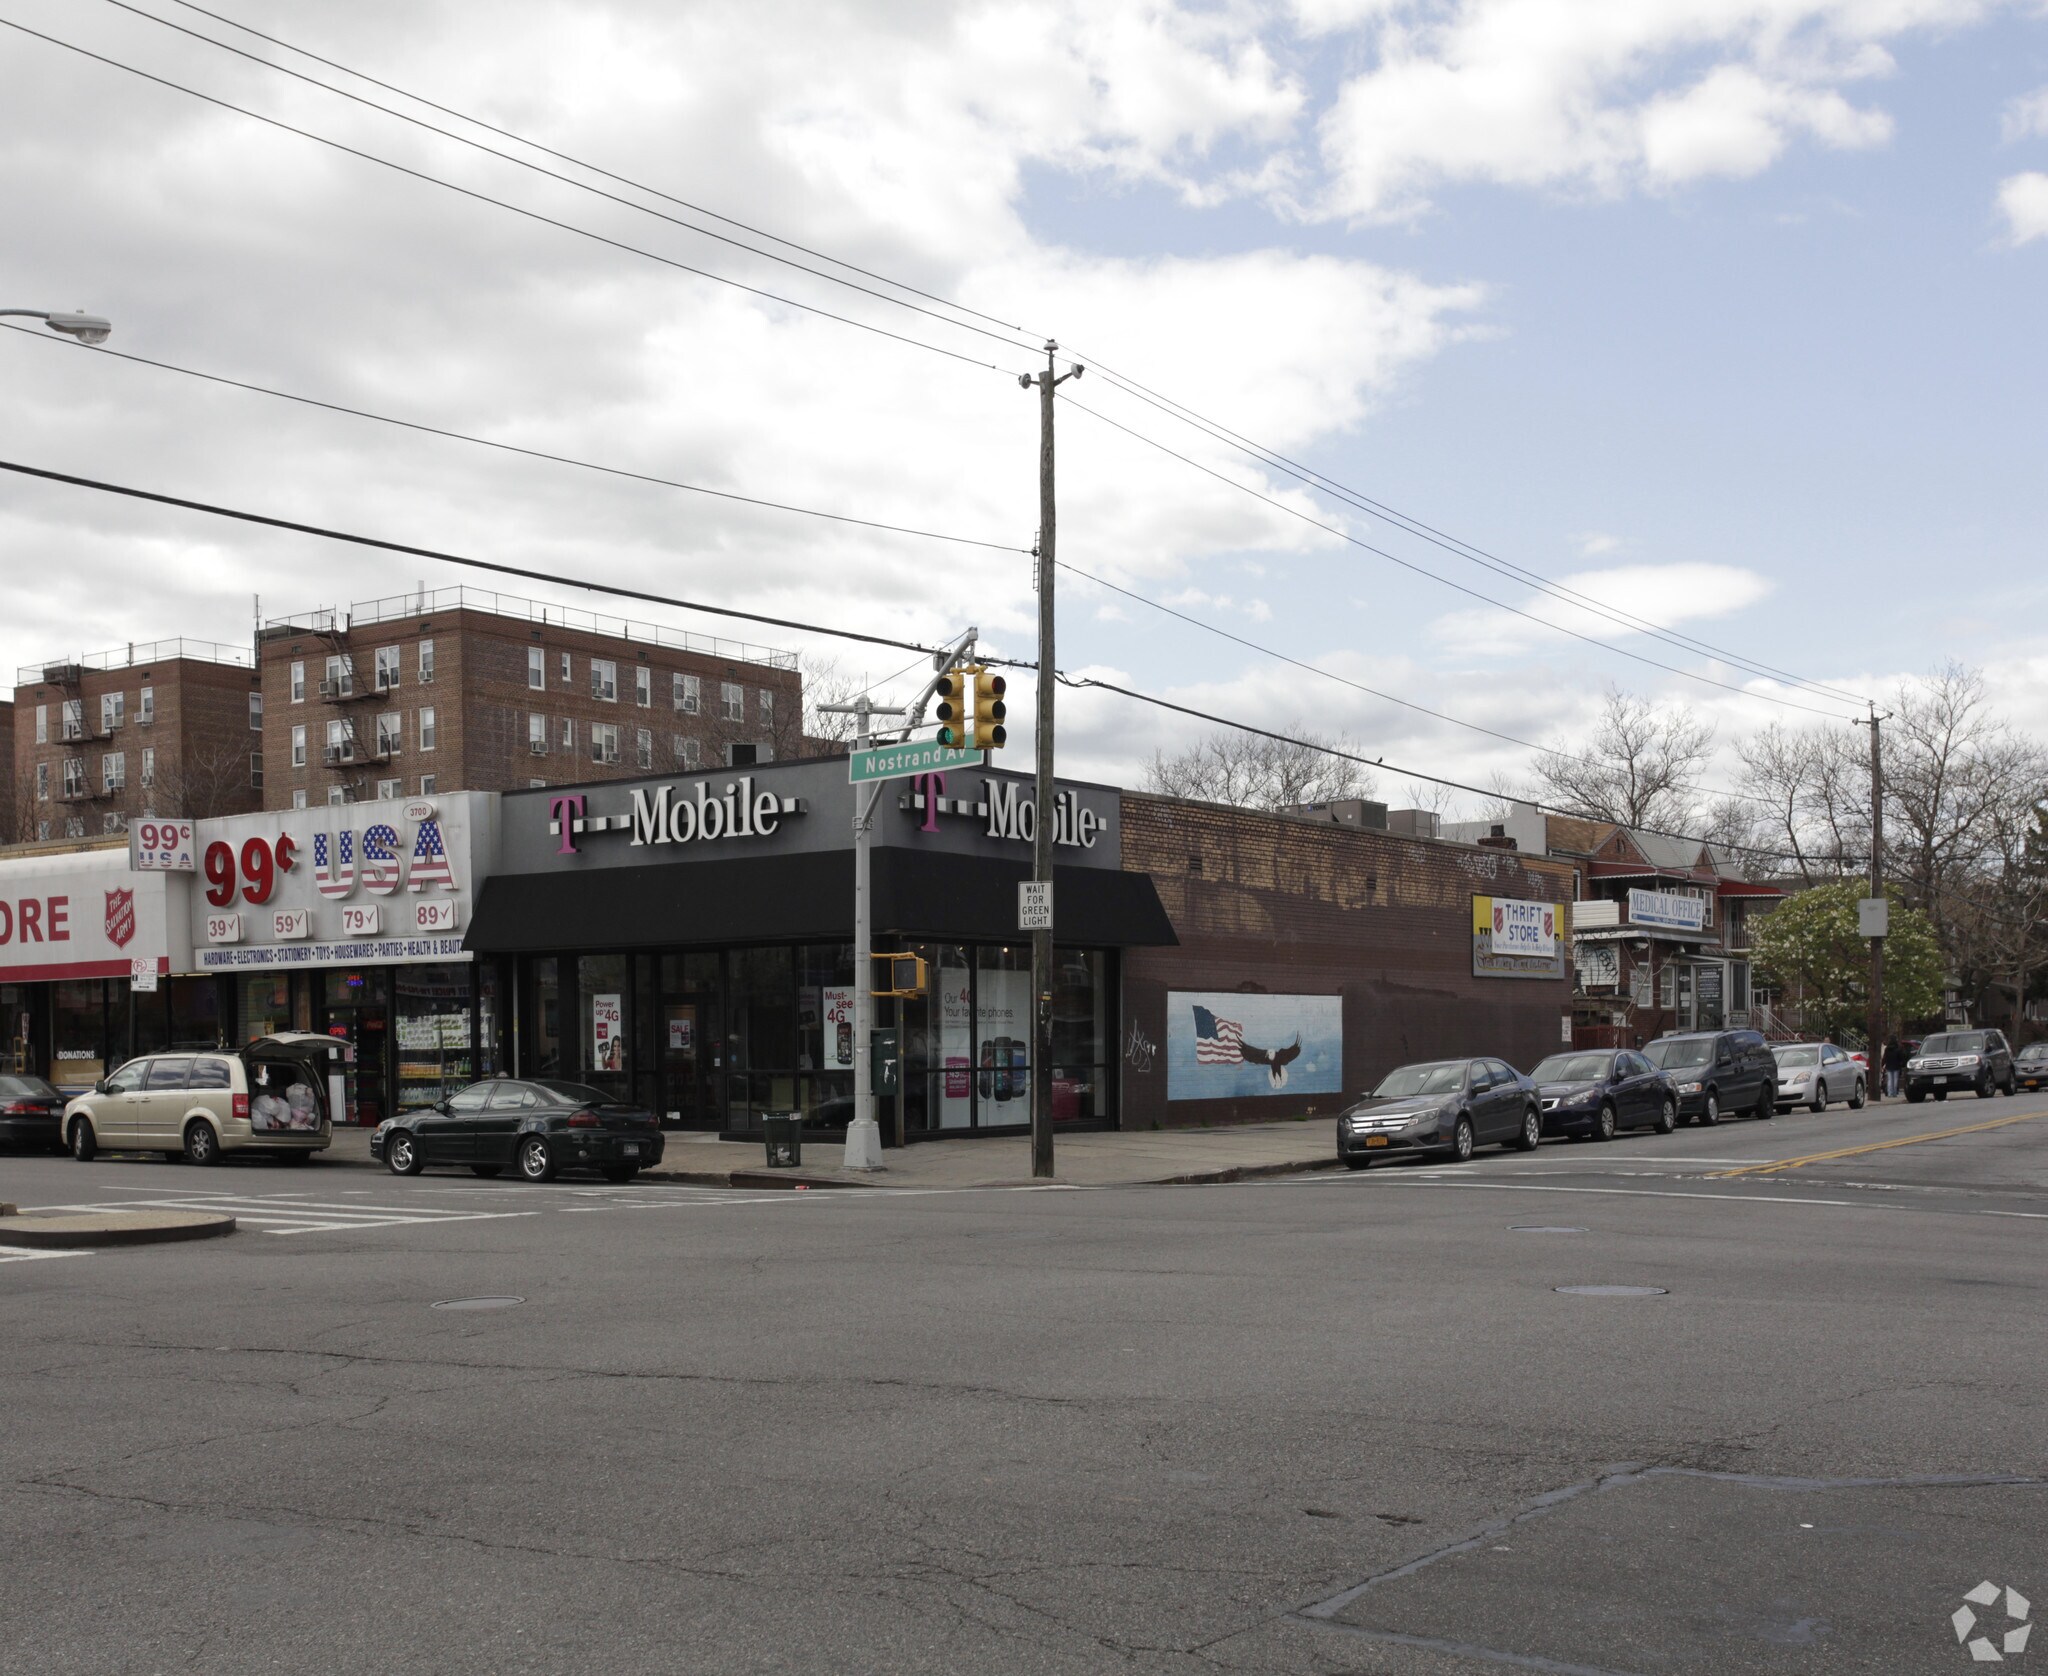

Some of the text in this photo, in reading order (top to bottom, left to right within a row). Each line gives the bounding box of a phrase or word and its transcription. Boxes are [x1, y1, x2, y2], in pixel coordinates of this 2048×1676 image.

[866, 745, 941, 774] Nostrand
[410, 807, 427, 817] 3700
[314, 821, 459, 899] USA
[204, 832, 302, 907] 99¢
[1026, 885, 1045, 894] WAIT
[109, 892, 122, 913] THE
[1027, 895, 1044, 905] FOR
[1631, 892, 1702, 920] MEDICAL OFFICE
[105, 897, 132, 935] SALVATION
[1022, 905, 1049, 915] GREEN
[1505, 904, 1542, 923] THRIFT
[1024, 916, 1047, 926] LIGHT
[116, 914, 133, 942] ARMY
[1509, 924, 1539, 943] STORE
[203, 951, 234, 966] HARDWARE
[238, 949, 274, 964] ELECTRONICS
[278, 947, 311, 962] STATIONERY
[316, 946, 330, 960] TOYS
[334, 943, 374, 959] HOUSEWARES
[378, 942, 403, 957] PARTIES
[408, 940, 430, 955] HEALTH
[825, 991, 848, 1000] Must-
[944, 992, 958, 1004] Our
[595, 1001, 614, 1009] Power
[836, 1000, 853, 1009] see
[604, 1009, 619, 1021] 4G
[827, 1008, 846, 1023] 4G
[944, 1006, 960, 1017] Your
[671, 1024, 689, 1034] SALE
[58, 1050, 95, 1060] DONATIONS
